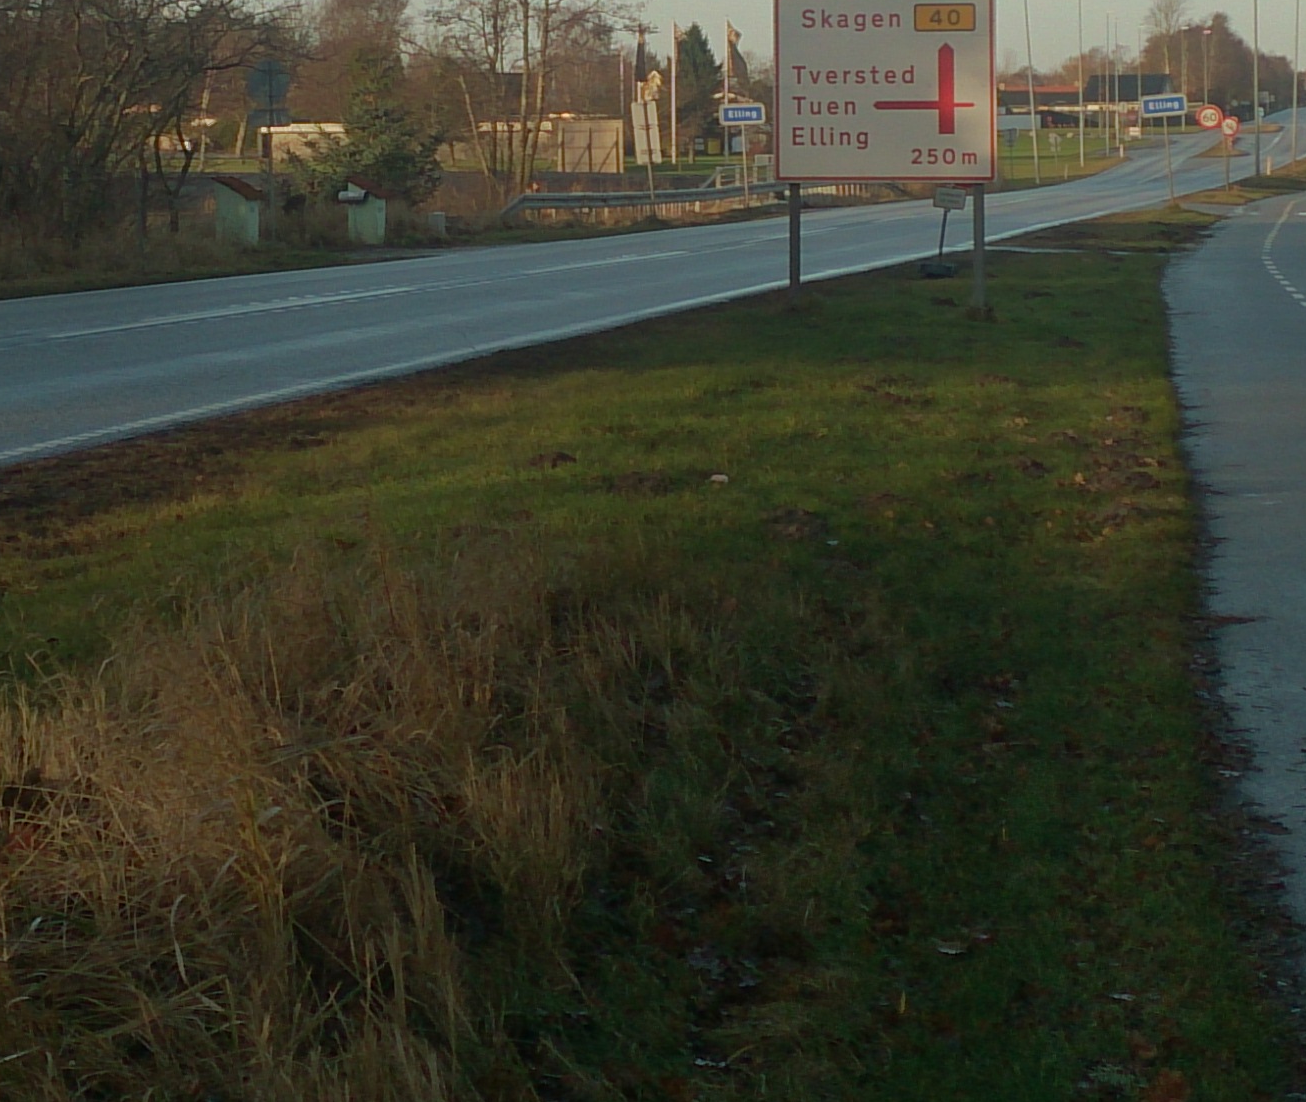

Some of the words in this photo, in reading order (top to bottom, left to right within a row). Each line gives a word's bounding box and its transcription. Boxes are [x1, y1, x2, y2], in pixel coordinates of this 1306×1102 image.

[801, 8, 901, 32] Skagen
[929, 9, 961, 26] 40
[792, 65, 915, 85] Tversted
[727, 109, 758, 119] Elling
[792, 96, 857, 115] Tuen
[1148, 101, 1179, 110] Elling
[1203, 112, 1217, 123] 60
[792, 127, 869, 150] Elling
[911, 148, 956, 165] 250
[961, 151, 978, 165] m
